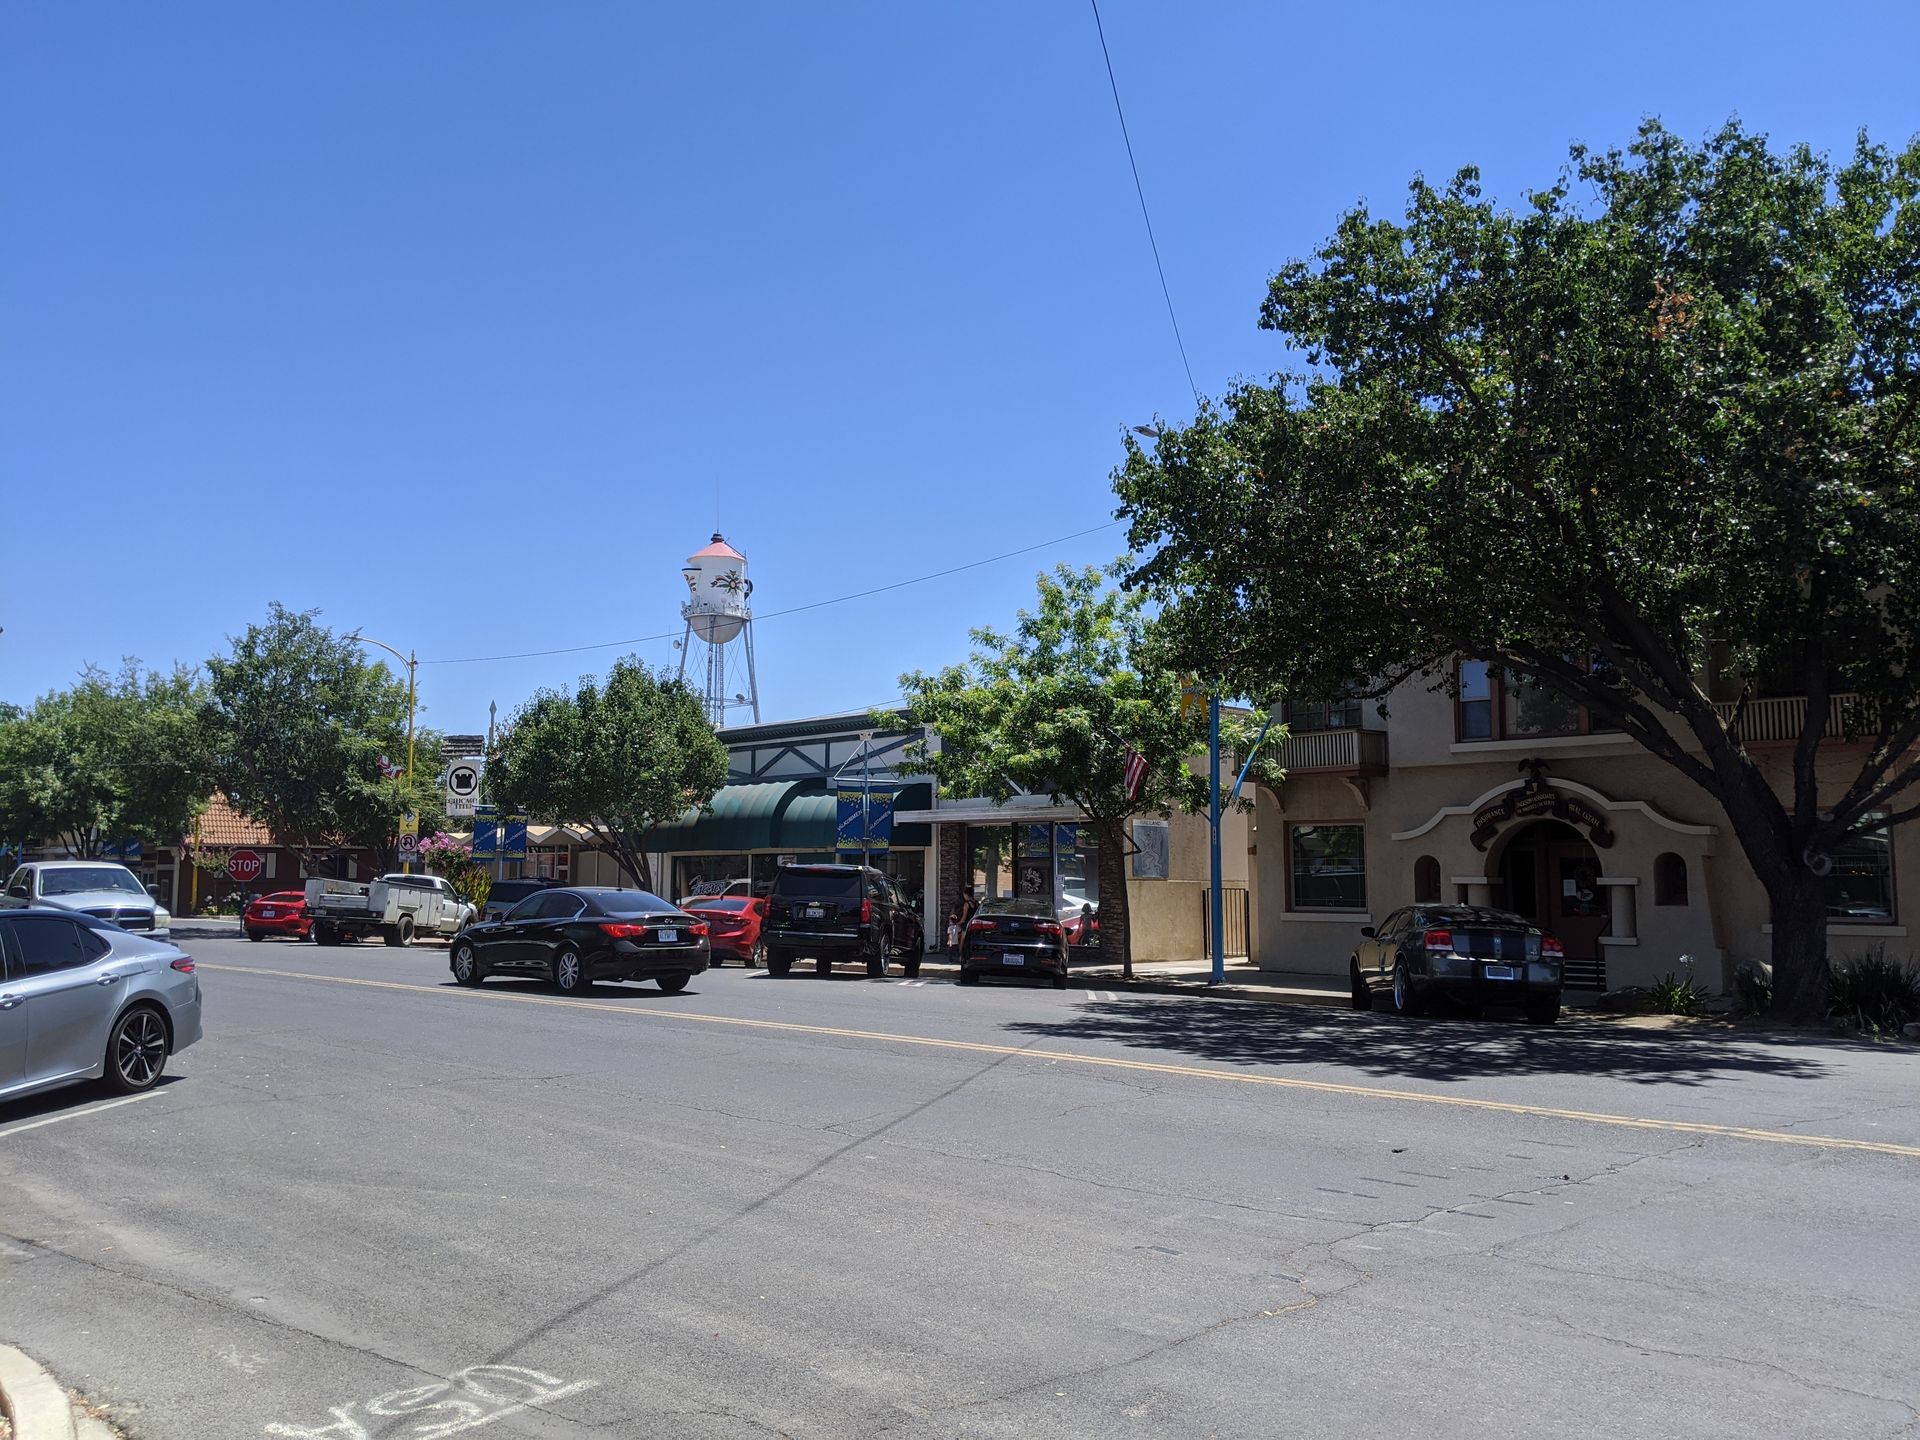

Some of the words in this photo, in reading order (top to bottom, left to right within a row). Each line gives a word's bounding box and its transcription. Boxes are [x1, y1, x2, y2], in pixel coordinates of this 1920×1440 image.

[1475, 807, 1505, 828] INSURANCE
[1582, 811, 1601, 827] ESTATE
[229, 860, 260, 872] STOP
